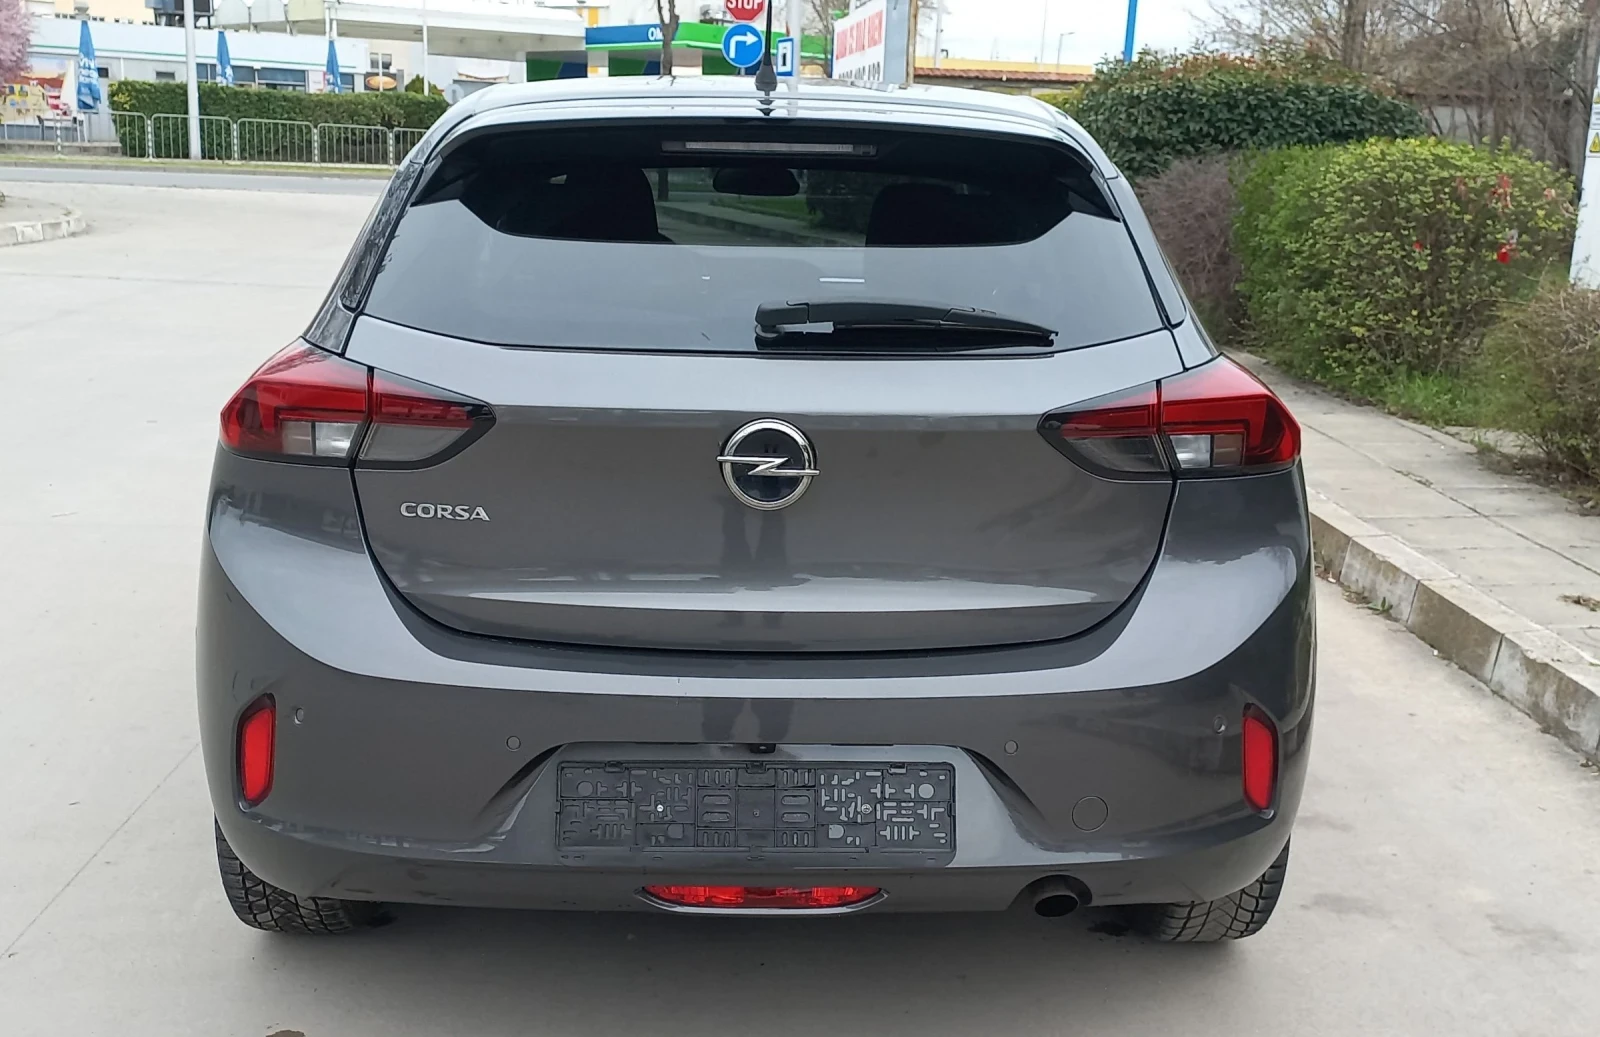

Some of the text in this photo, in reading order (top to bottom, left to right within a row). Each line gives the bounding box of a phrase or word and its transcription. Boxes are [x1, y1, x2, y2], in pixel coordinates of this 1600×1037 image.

[727, 0, 763, 10] STOP
[648, 27, 664, 41] OM
[399, 502, 491, 521] CORSA
